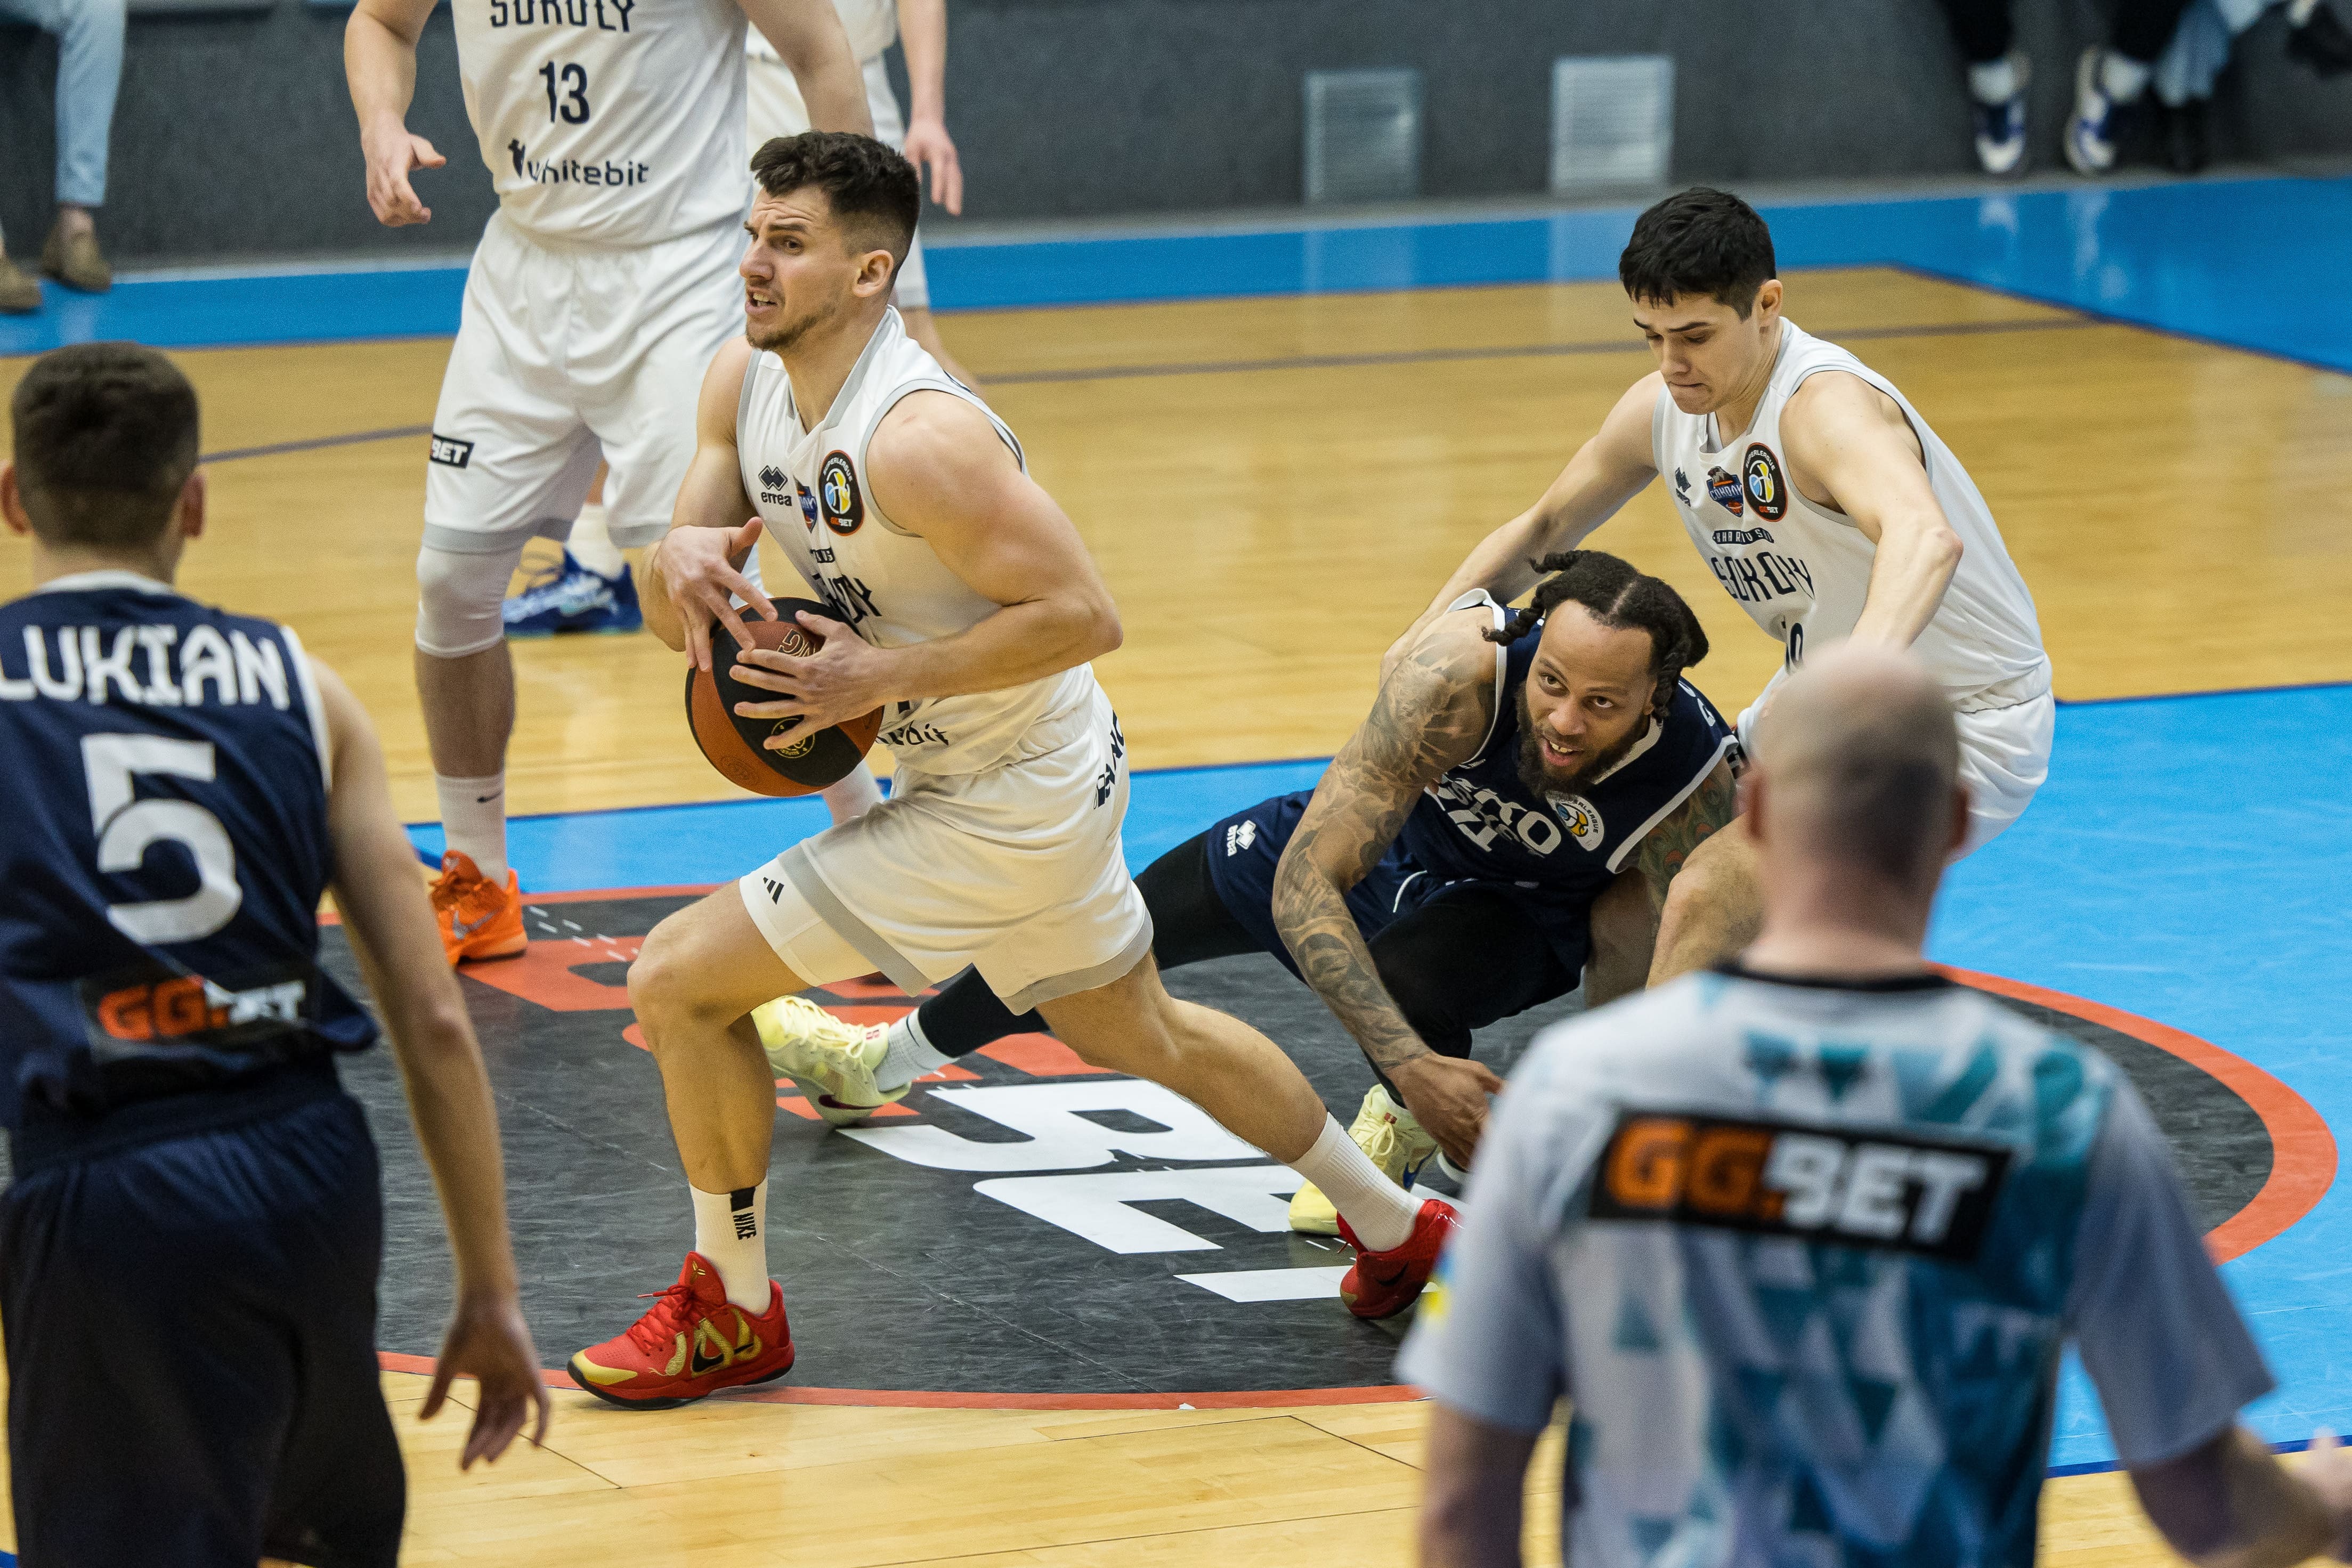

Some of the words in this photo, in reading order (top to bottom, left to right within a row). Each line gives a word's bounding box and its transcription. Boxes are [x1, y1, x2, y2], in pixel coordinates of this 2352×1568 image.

[539, 61, 590, 124] 13
[761, 492, 792, 506] errea
[80, 733, 242, 945] 5
[1604, 1117, 1989, 1247] GG.BET
[733, 1212, 757, 1240] NIKE
